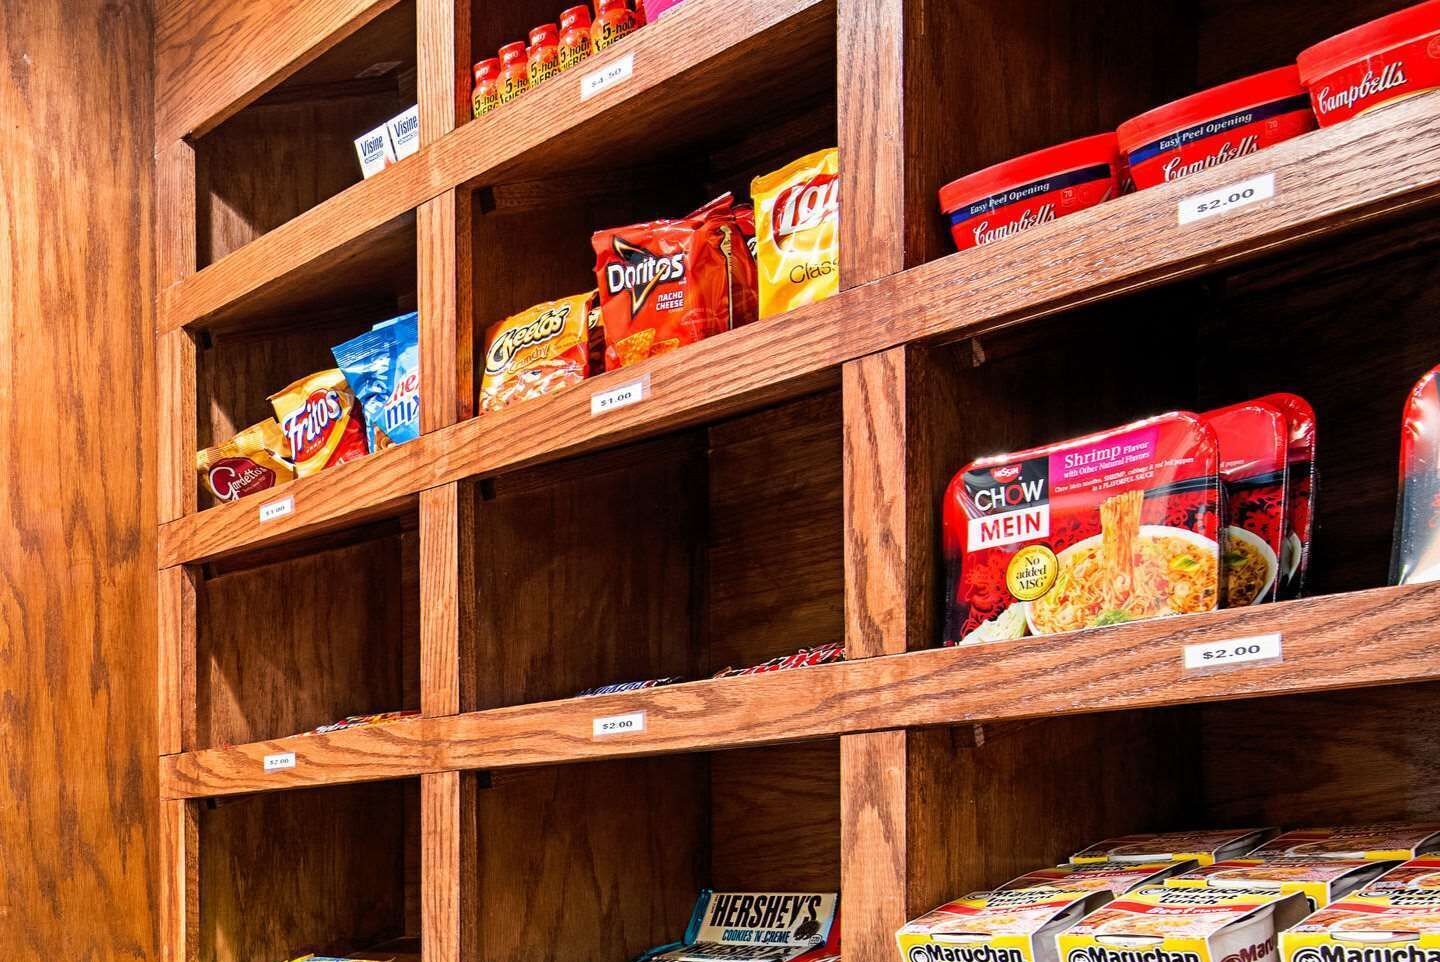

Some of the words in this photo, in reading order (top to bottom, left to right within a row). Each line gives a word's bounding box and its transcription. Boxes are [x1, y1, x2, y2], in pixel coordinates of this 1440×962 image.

[1317, 61, 1408, 116] Campbell's
[394, 115, 418, 138] Visine
[1160, 135, 1179, 151] Easy
[1181, 126, 1204, 143] Peel
[1205, 111, 1253, 136] Opening
[361, 135, 384, 157] Visine
[969, 203, 988, 216] Easy
[989, 194, 1007, 208] Peel
[1008, 181, 1050, 203] Opening
[1196, 187, 1255, 214] $2.00
[607, 253, 685, 294] Doritos
[656, 299, 684, 311] CHEESE
[658, 291, 684, 302] NACHO
[485, 304, 570, 374] Cheetos
[508, 343, 550, 373] Crunchy
[600, 391, 632, 406] $1.00
[282, 389, 343, 464] Fritos
[1063, 468, 1079, 478] with
[1079, 465, 1098, 476] Other
[1099, 458, 1124, 471] Natural
[1125, 453, 1150, 465] Flavors
[1064, 446, 1121, 469] Shrimp
[1123, 441, 1149, 454] Flavor
[974, 479, 1044, 512] CHOW
[980, 511, 1041, 543] MEIN
[1015, 565, 1047, 581] added
[1025, 555, 1040, 567] No
[1202, 644, 1261, 660] $2.00
[601, 718, 633, 730] $2.00
[710, 894, 822, 928] HERSHEY'S
[722, 929, 752, 942] COOKIES
[764, 930, 791, 943] CREME
